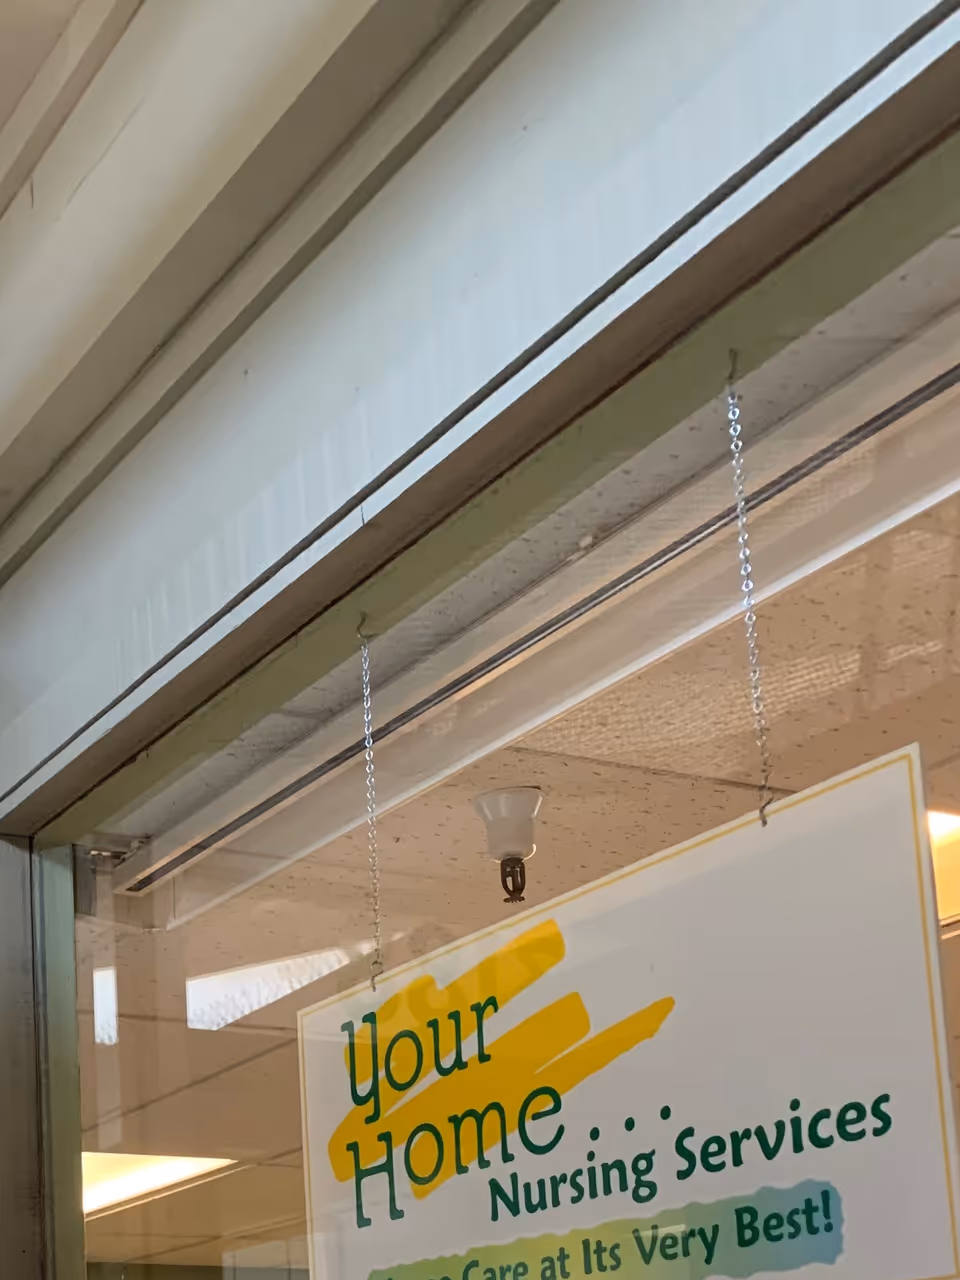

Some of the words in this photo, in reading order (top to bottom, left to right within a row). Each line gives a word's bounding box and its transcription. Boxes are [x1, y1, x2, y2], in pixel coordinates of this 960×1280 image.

[341, 995, 500, 1125] Your
[488, 1148, 658, 1223] Nursing
[674, 1093, 894, 1182] Services
[581, 1236, 622, 1275] Its
[631, 1223, 721, 1265] Very
[733, 1189, 835, 1249] Best!
